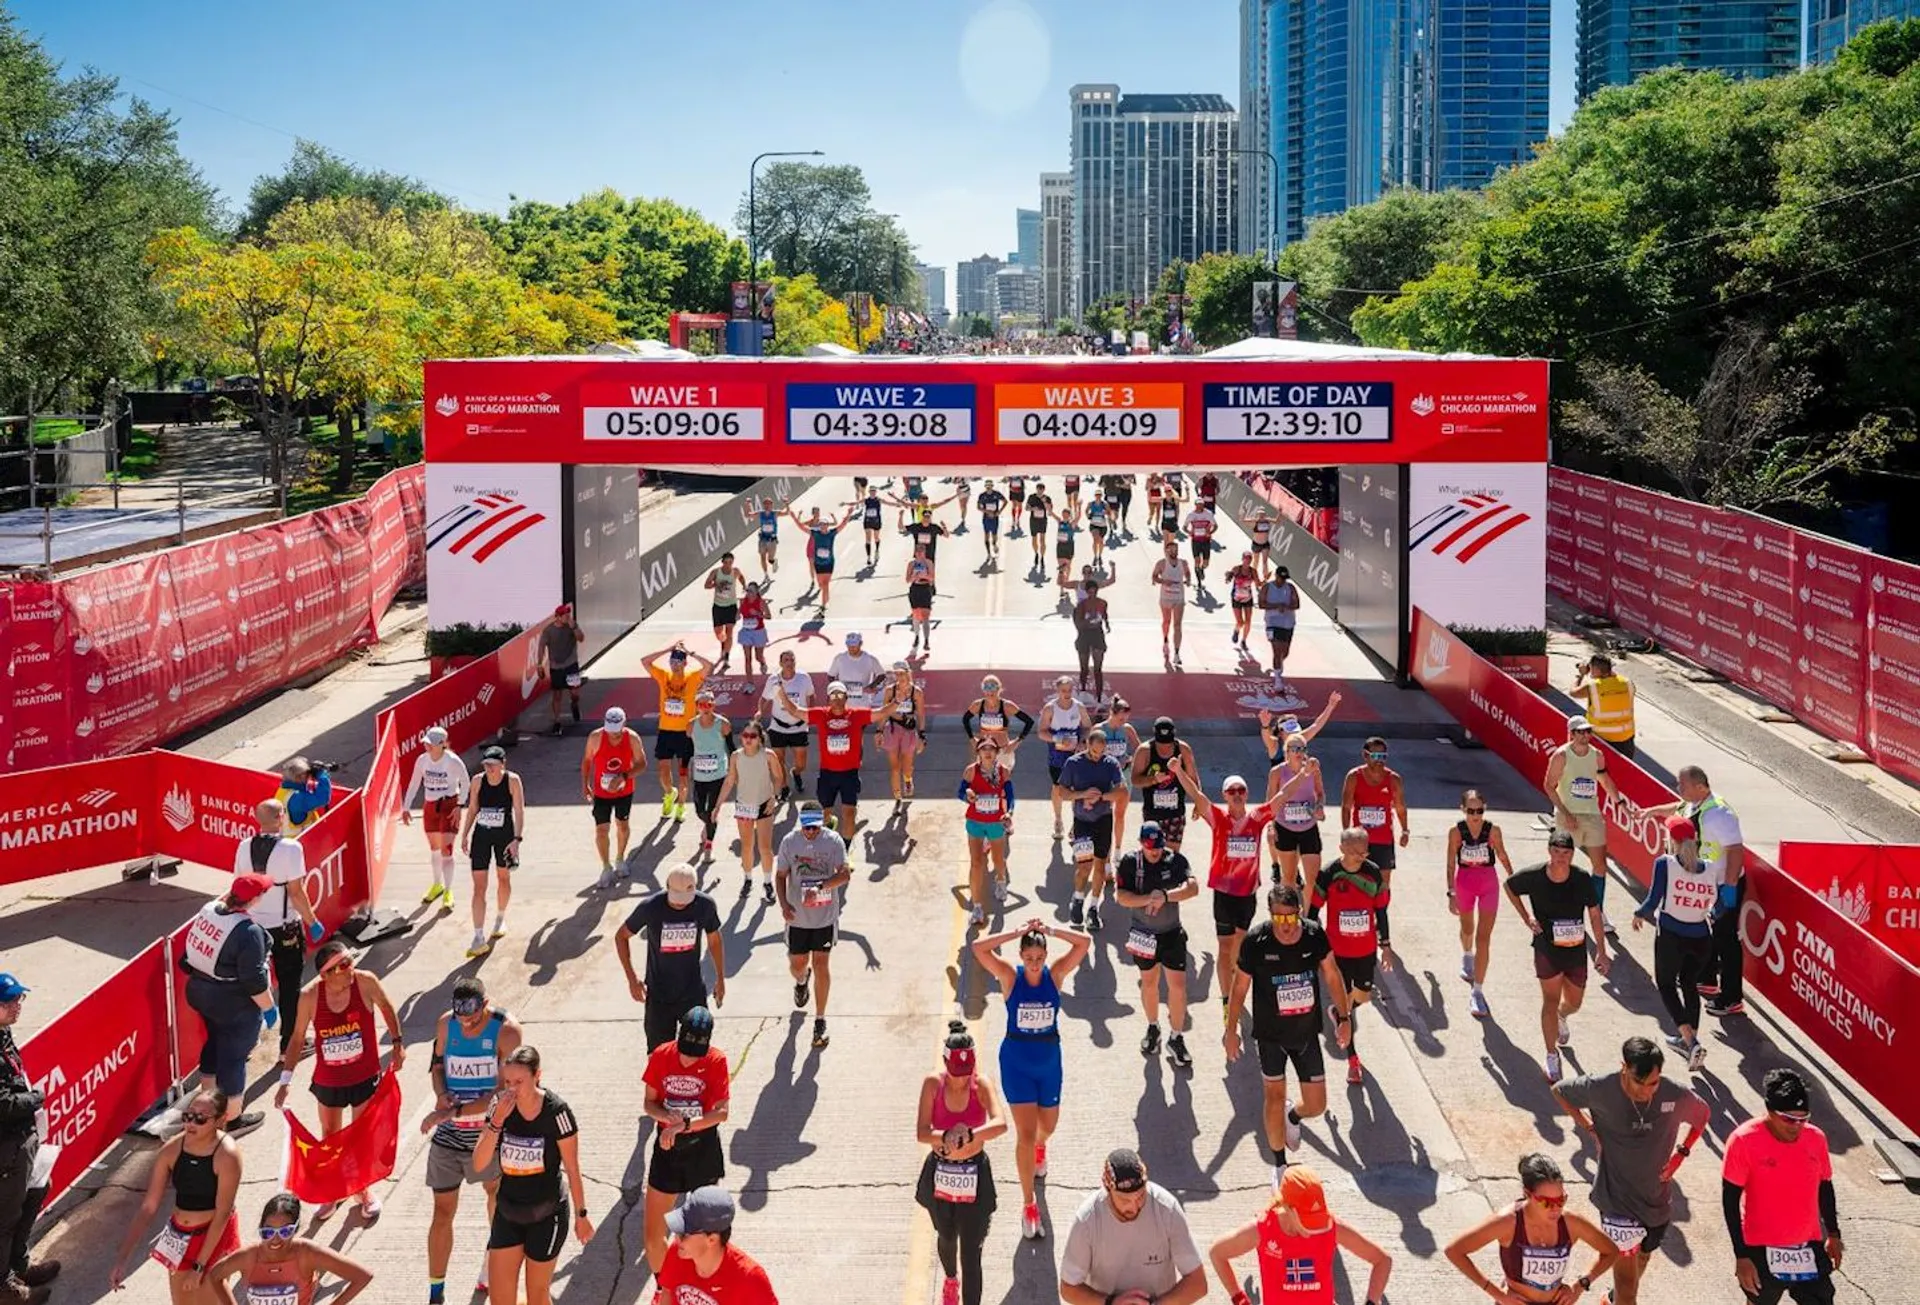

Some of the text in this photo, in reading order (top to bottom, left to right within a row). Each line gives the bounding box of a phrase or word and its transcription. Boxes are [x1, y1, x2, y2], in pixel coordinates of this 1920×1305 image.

[630, 386, 717, 406] WAVE 1
[836, 387, 926, 406] WAVE 2
[1044, 387, 1135, 406] WAVE 3
[1223, 386, 1372, 406] TIME OF DAY
[1440, 394, 1463, 402] BANK
[464, 404, 560, 414] CHICAGO MARATHON
[1440, 404, 1537, 414] CHICAGO MARATHON
[606, 411, 740, 436] 05:09:06
[813, 412, 947, 437] 04:39:08
[1023, 412, 1157, 437] 04:04:09
[1241, 412, 1362, 436] 12:39:10
[698, 519, 726, 557] KIA
[1268, 523, 1295, 556] KIA
[641, 552, 678, 599] KIA
[1306, 554, 1339, 597] KIA
[1470, 689, 1540, 753] BANK OF AMERICA
[201, 794, 230, 812] BANK
[232, 804, 247, 816] OF
[1, 808, 138, 850] MARATHON
[201, 814, 257, 841] CHICAGO
[1675, 879, 1715, 896] CODE
[196, 915, 224, 943] CODE
[187, 931, 214, 960] TEAM
[1795, 920, 1836, 971] TATA
[1278, 988, 1313, 1003] H43095
[1791, 972, 1853, 1041] SERVICES
[1792, 948, 1896, 1047] CONSULTANCY
[1019, 1010, 1052, 1023] J45713
[320, 1022, 361, 1038] CHINA
[450, 1061, 494, 1077] MATT
[502, 1145, 541, 1162] K72204
[935, 1173, 975, 1189] H38201
[1525, 1259, 1567, 1277] J24877
